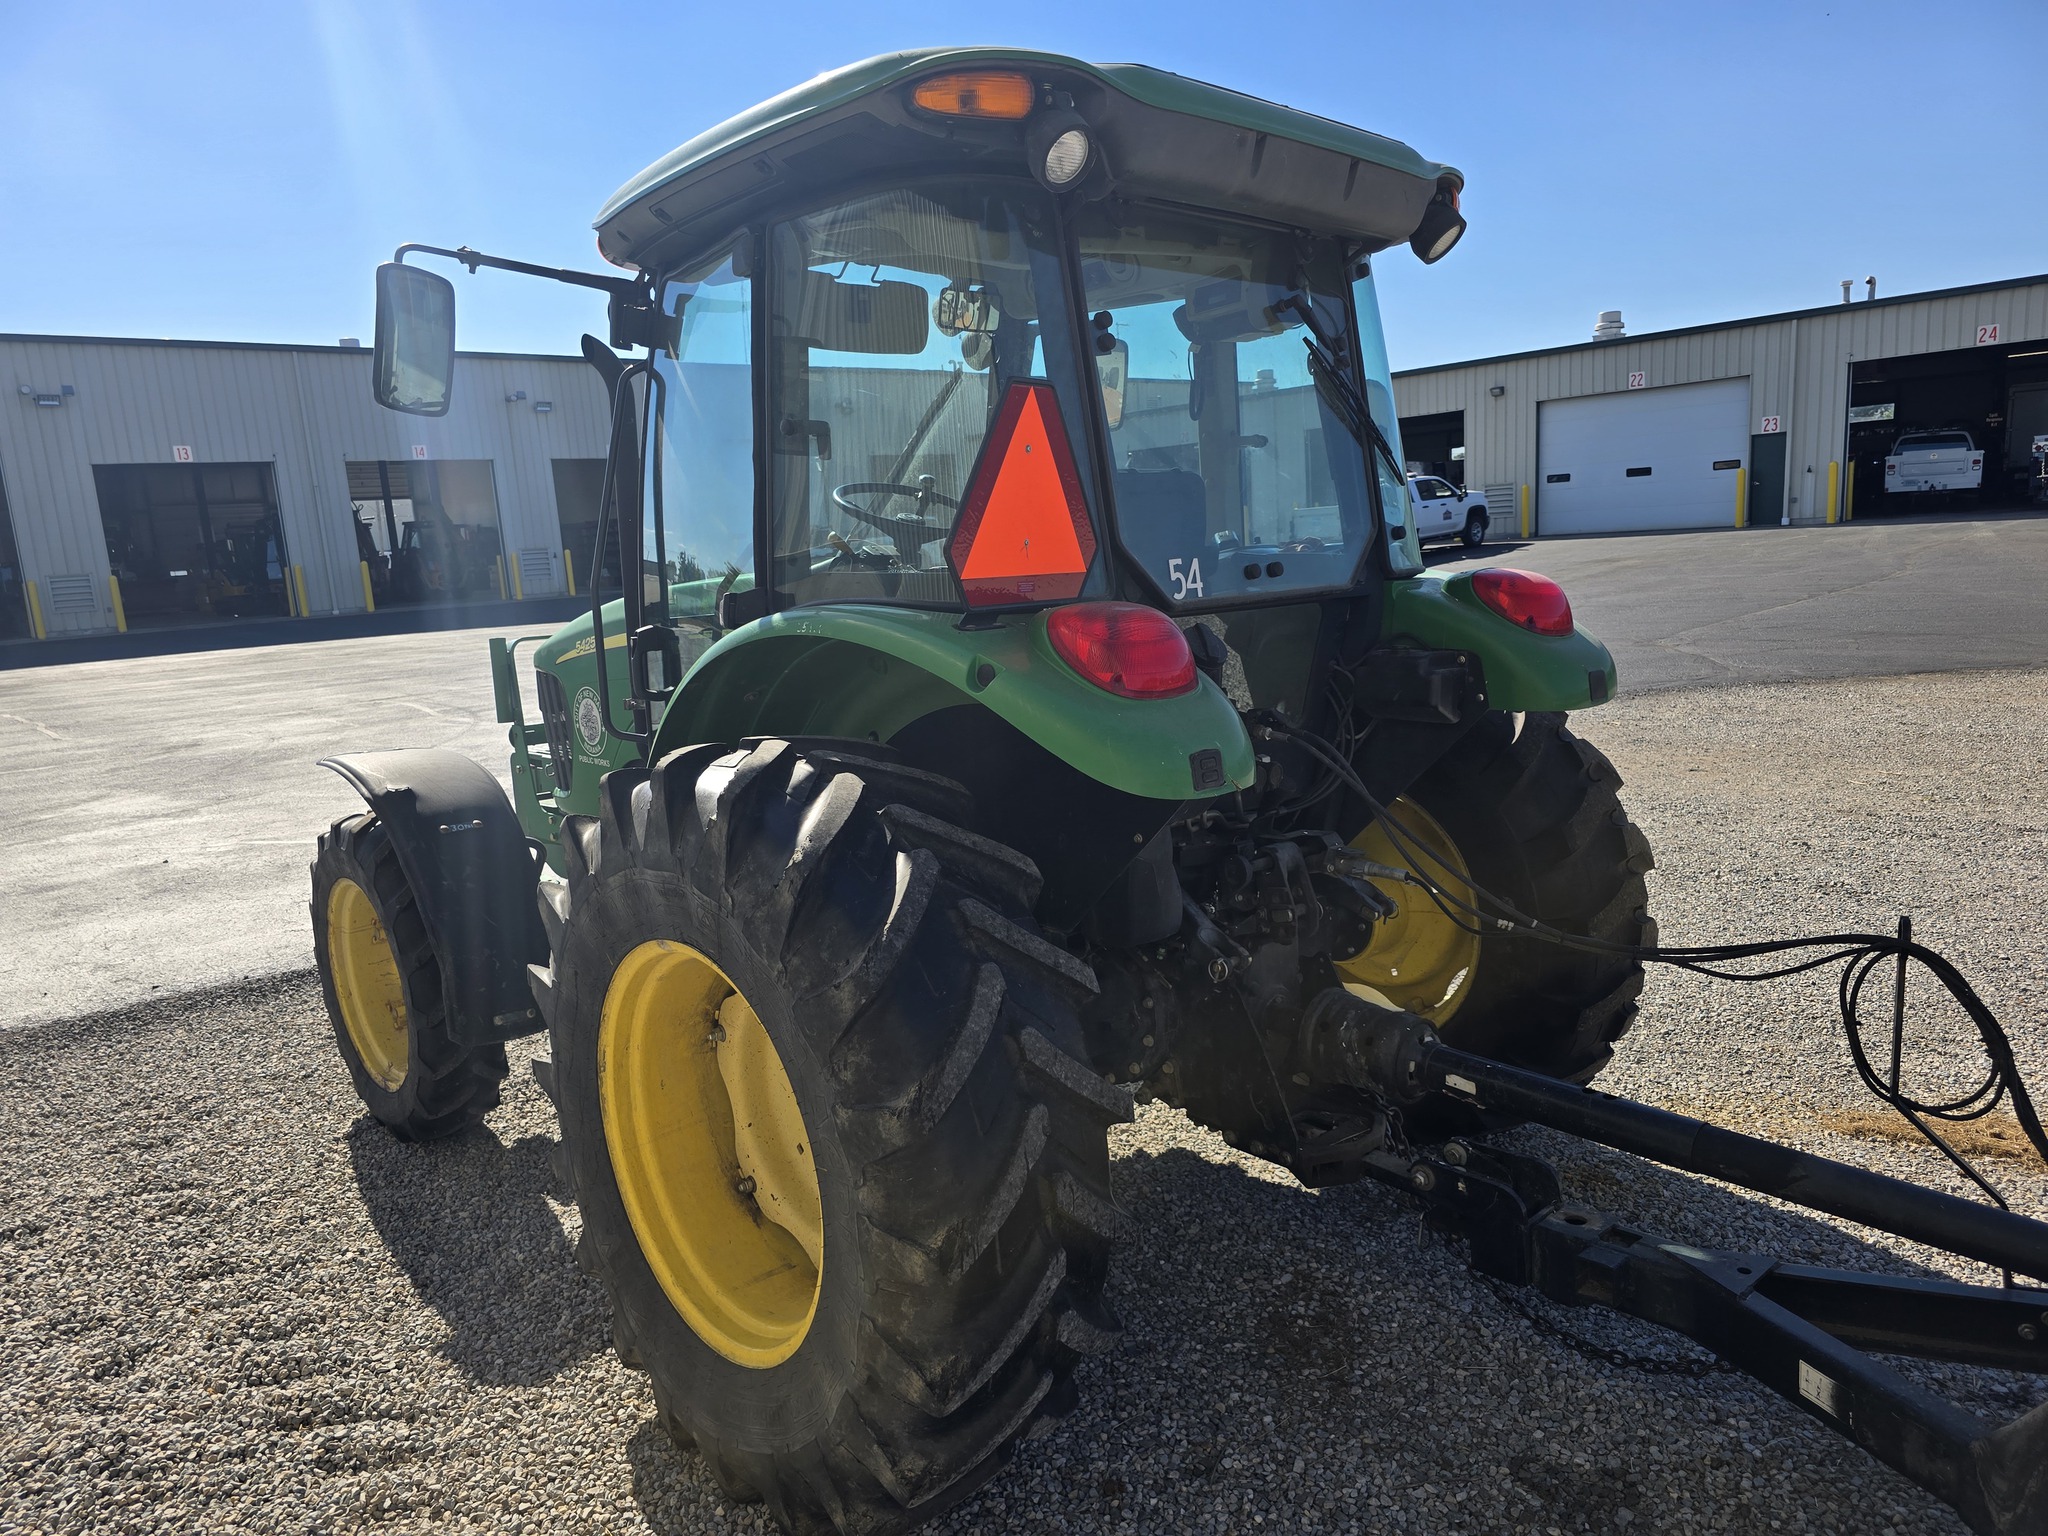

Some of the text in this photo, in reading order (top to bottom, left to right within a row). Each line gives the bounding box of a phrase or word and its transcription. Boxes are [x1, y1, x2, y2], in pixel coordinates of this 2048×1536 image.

[1978, 325, 1998, 343] 24
[1630, 373, 1643, 387] 22
[1763, 417, 1778, 432] 23
[176, 447, 190, 461] 13
[414, 446, 425, 459] 14
[1168, 557, 1204, 600] 54
[575, 635, 596, 654] 5425
[579, 755, 611, 767] PUBLIC WORKS
